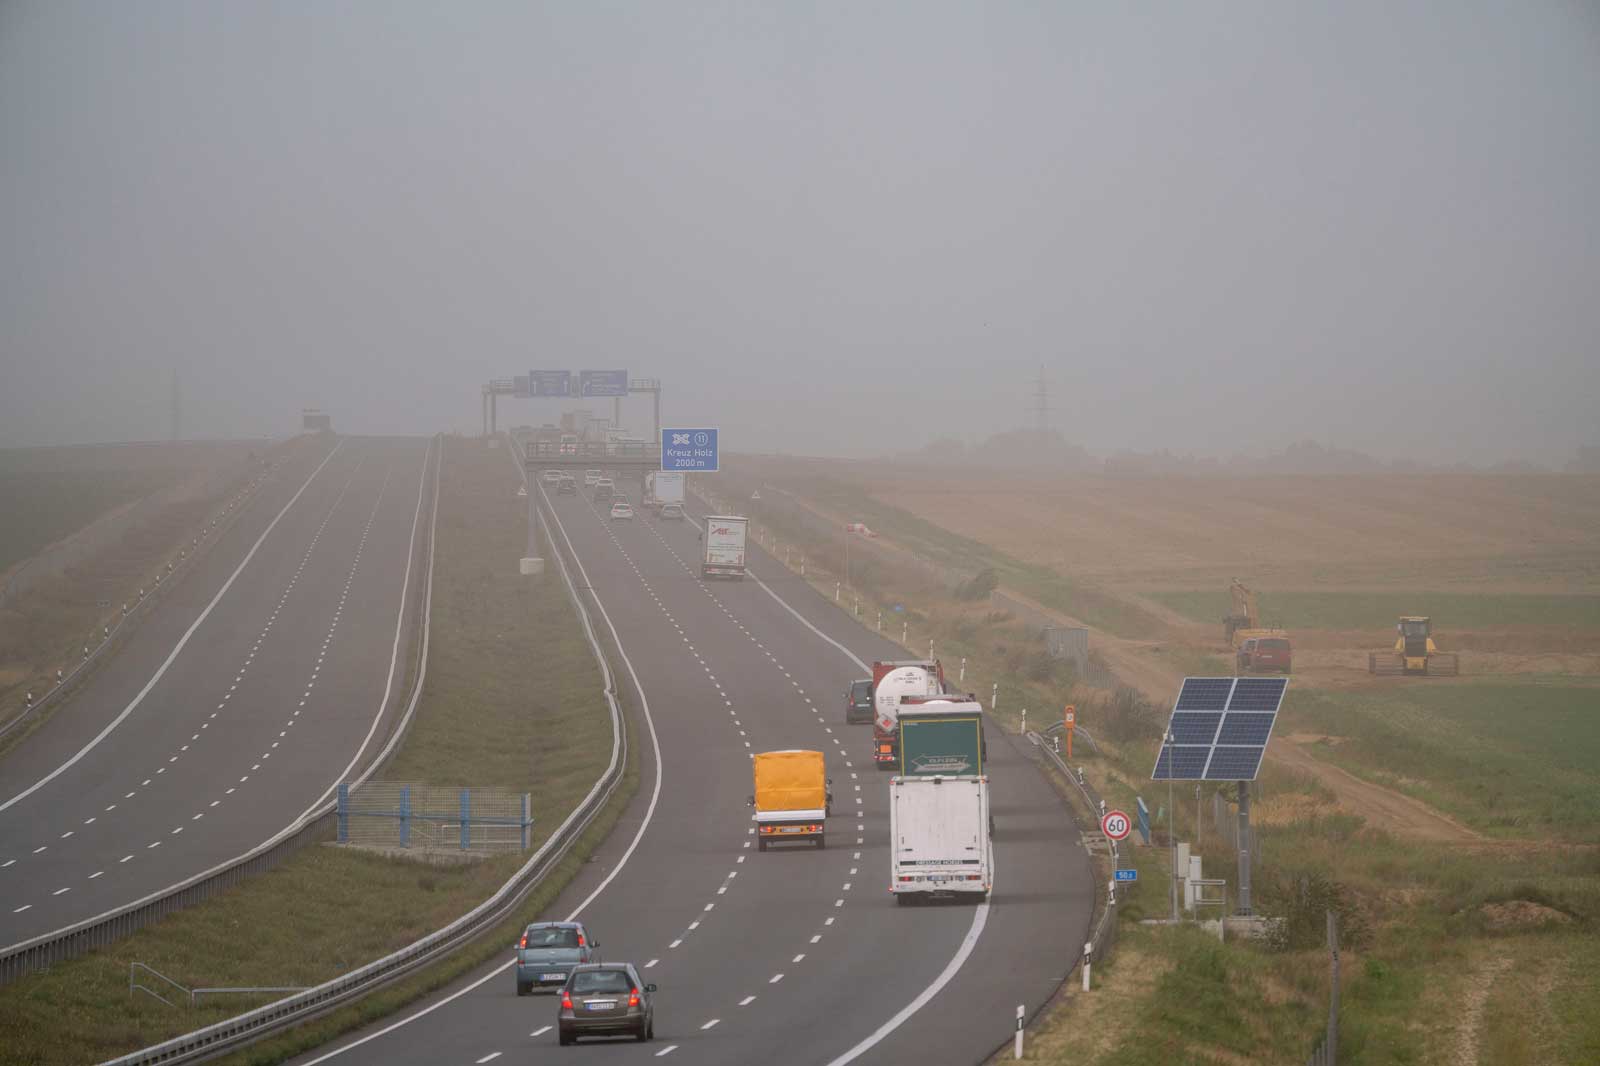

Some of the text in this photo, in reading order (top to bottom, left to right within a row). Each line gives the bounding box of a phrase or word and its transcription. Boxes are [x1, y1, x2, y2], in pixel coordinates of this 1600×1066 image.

[698, 435, 705, 443] 11
[667, 448, 713, 457] Kreuz Holz
[675, 459, 696, 467] 2000
[1109, 819, 1125, 832] 60
